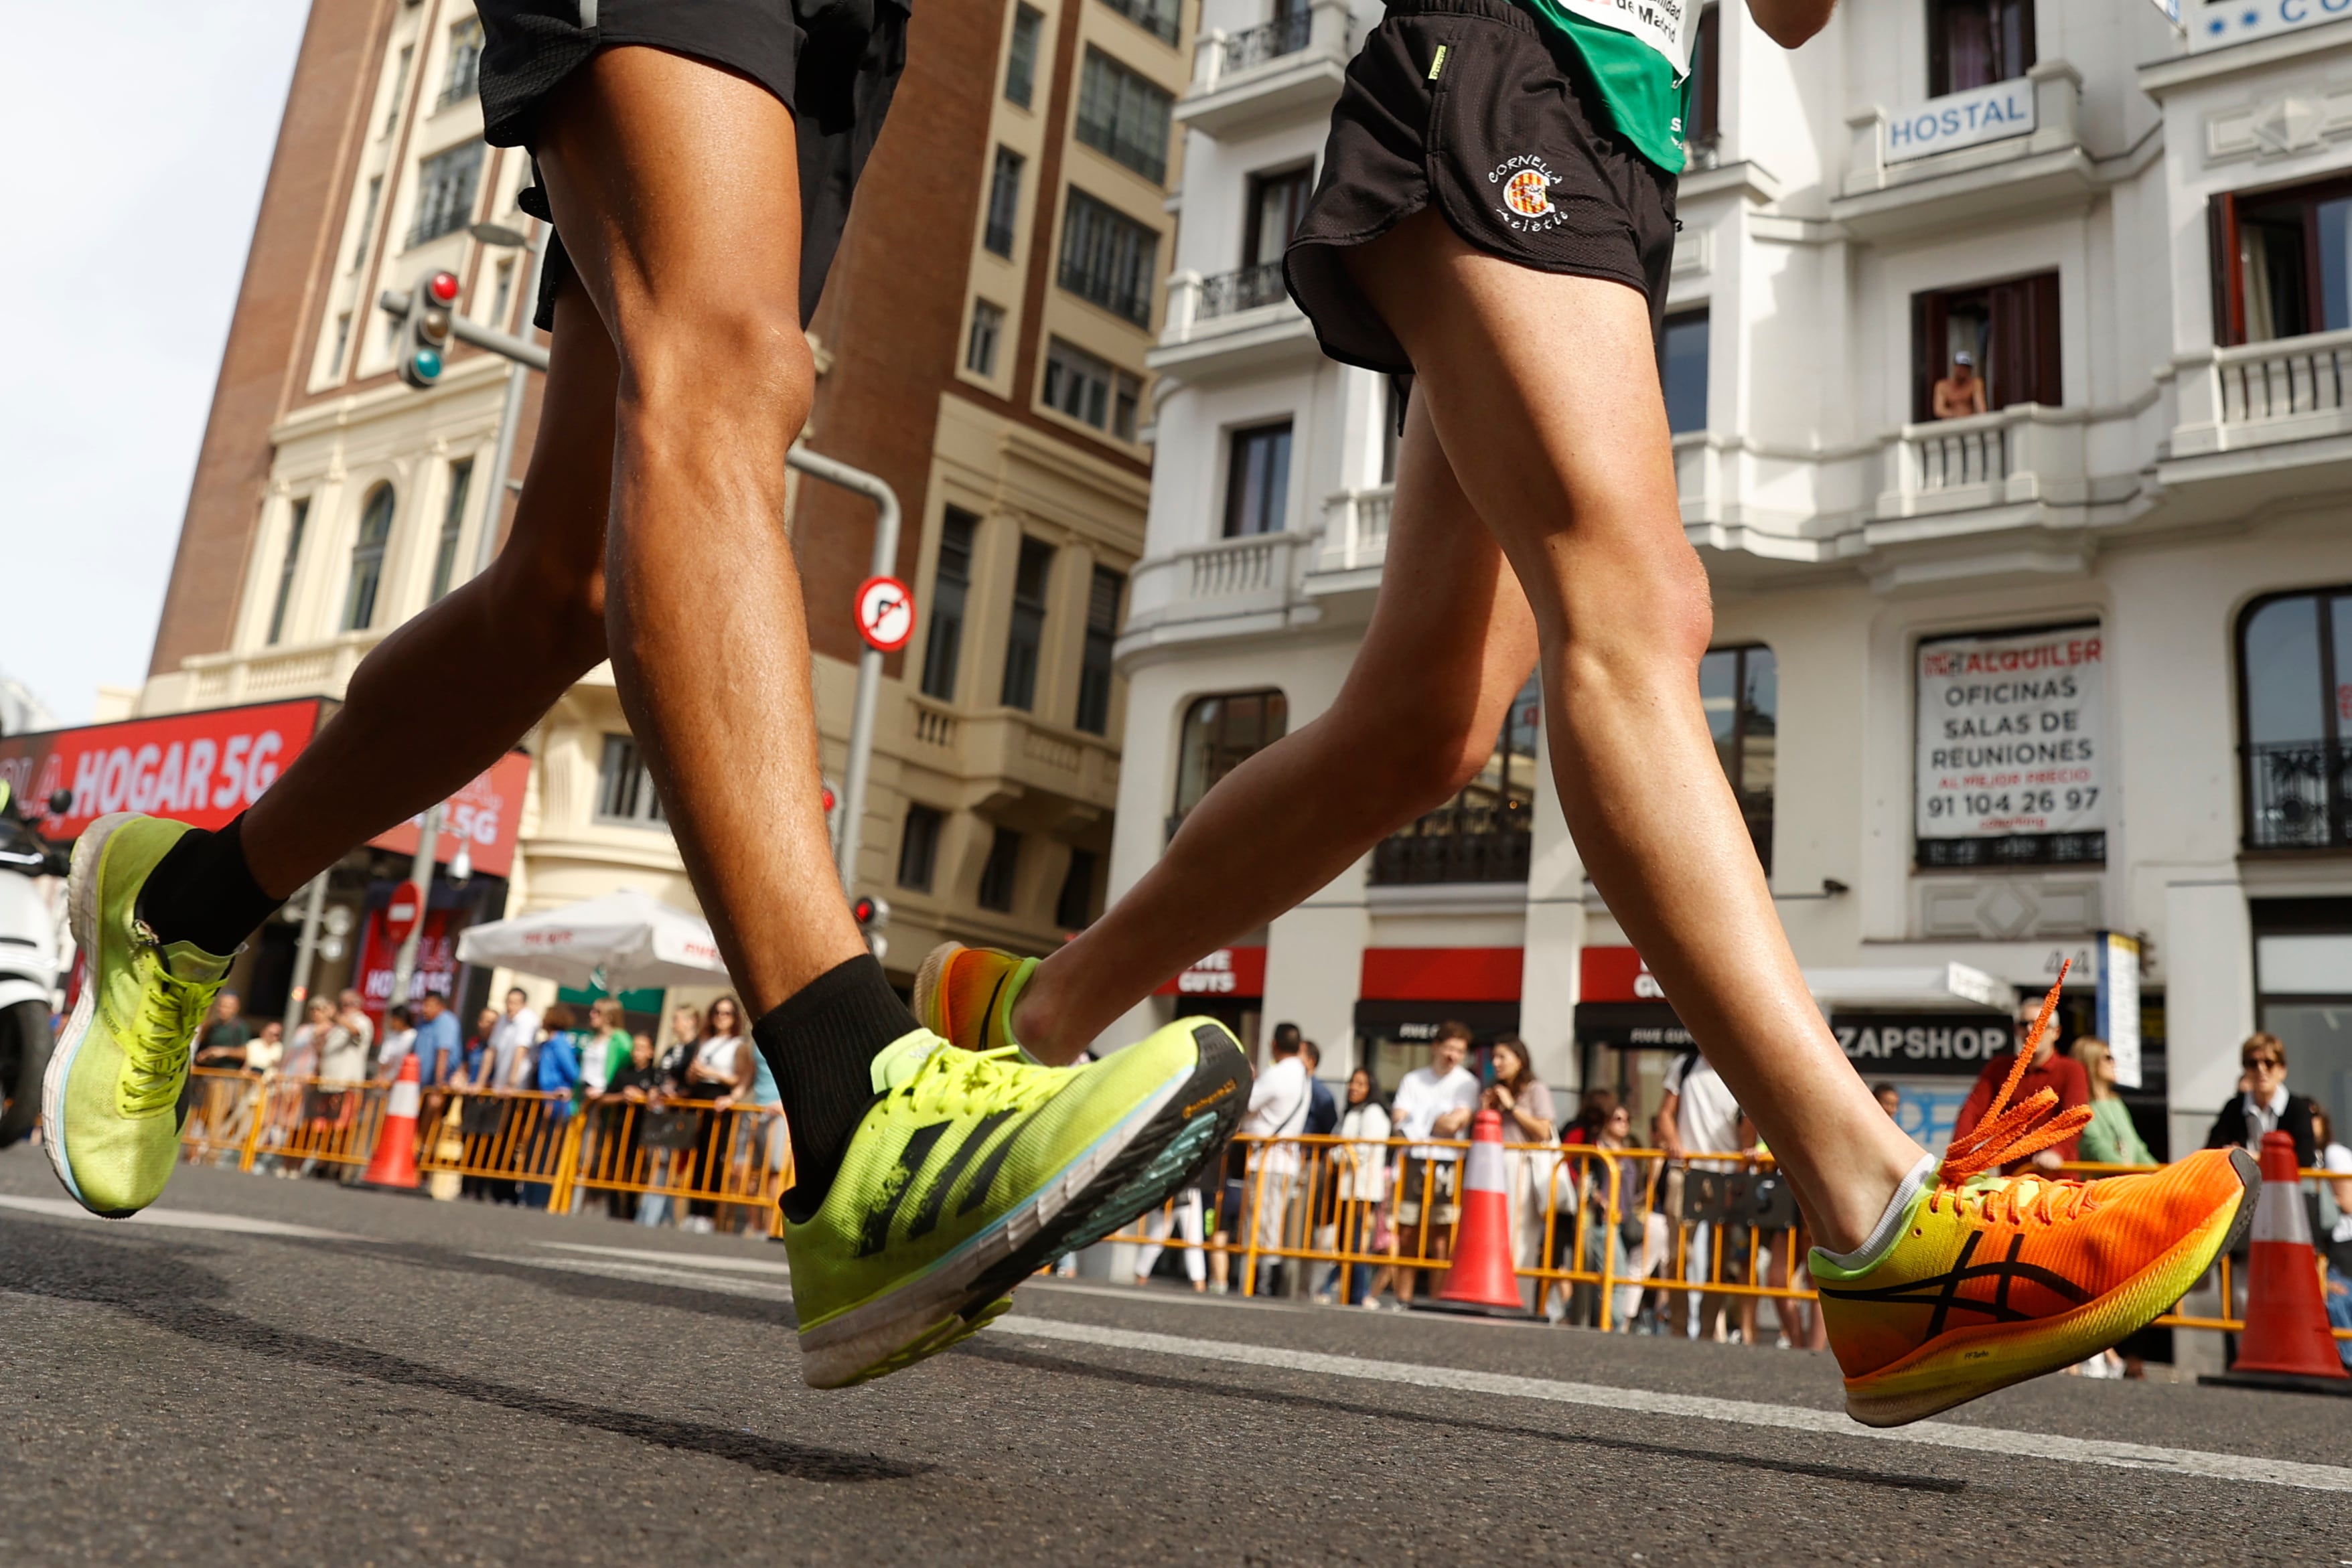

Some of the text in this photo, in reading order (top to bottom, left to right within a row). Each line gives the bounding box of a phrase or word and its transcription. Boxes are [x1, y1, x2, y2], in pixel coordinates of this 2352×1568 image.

[1891, 97, 2027, 147] HOSTAL
[1966, 638, 2102, 674] ALQUILER
[1945, 676, 2077, 707] OFICINAS
[1943, 710, 2079, 738] SALAS DE
[1932, 739, 2093, 769] REUNIONES
[68, 738, 218, 818] HOGAR
[212, 730, 283, 809] 5G
[1963, 772, 2020, 787] MEJOR
[2026, 768, 2090, 784] PRECIO
[1927, 787, 2100, 817] 91 104 26 97
[2045, 947, 2090, 977] 44
[1178, 971, 1237, 993] GUYS
[1630, 1028, 1663, 1043] FIVE
[1835, 1027, 2008, 1060] ZAPSHOP
